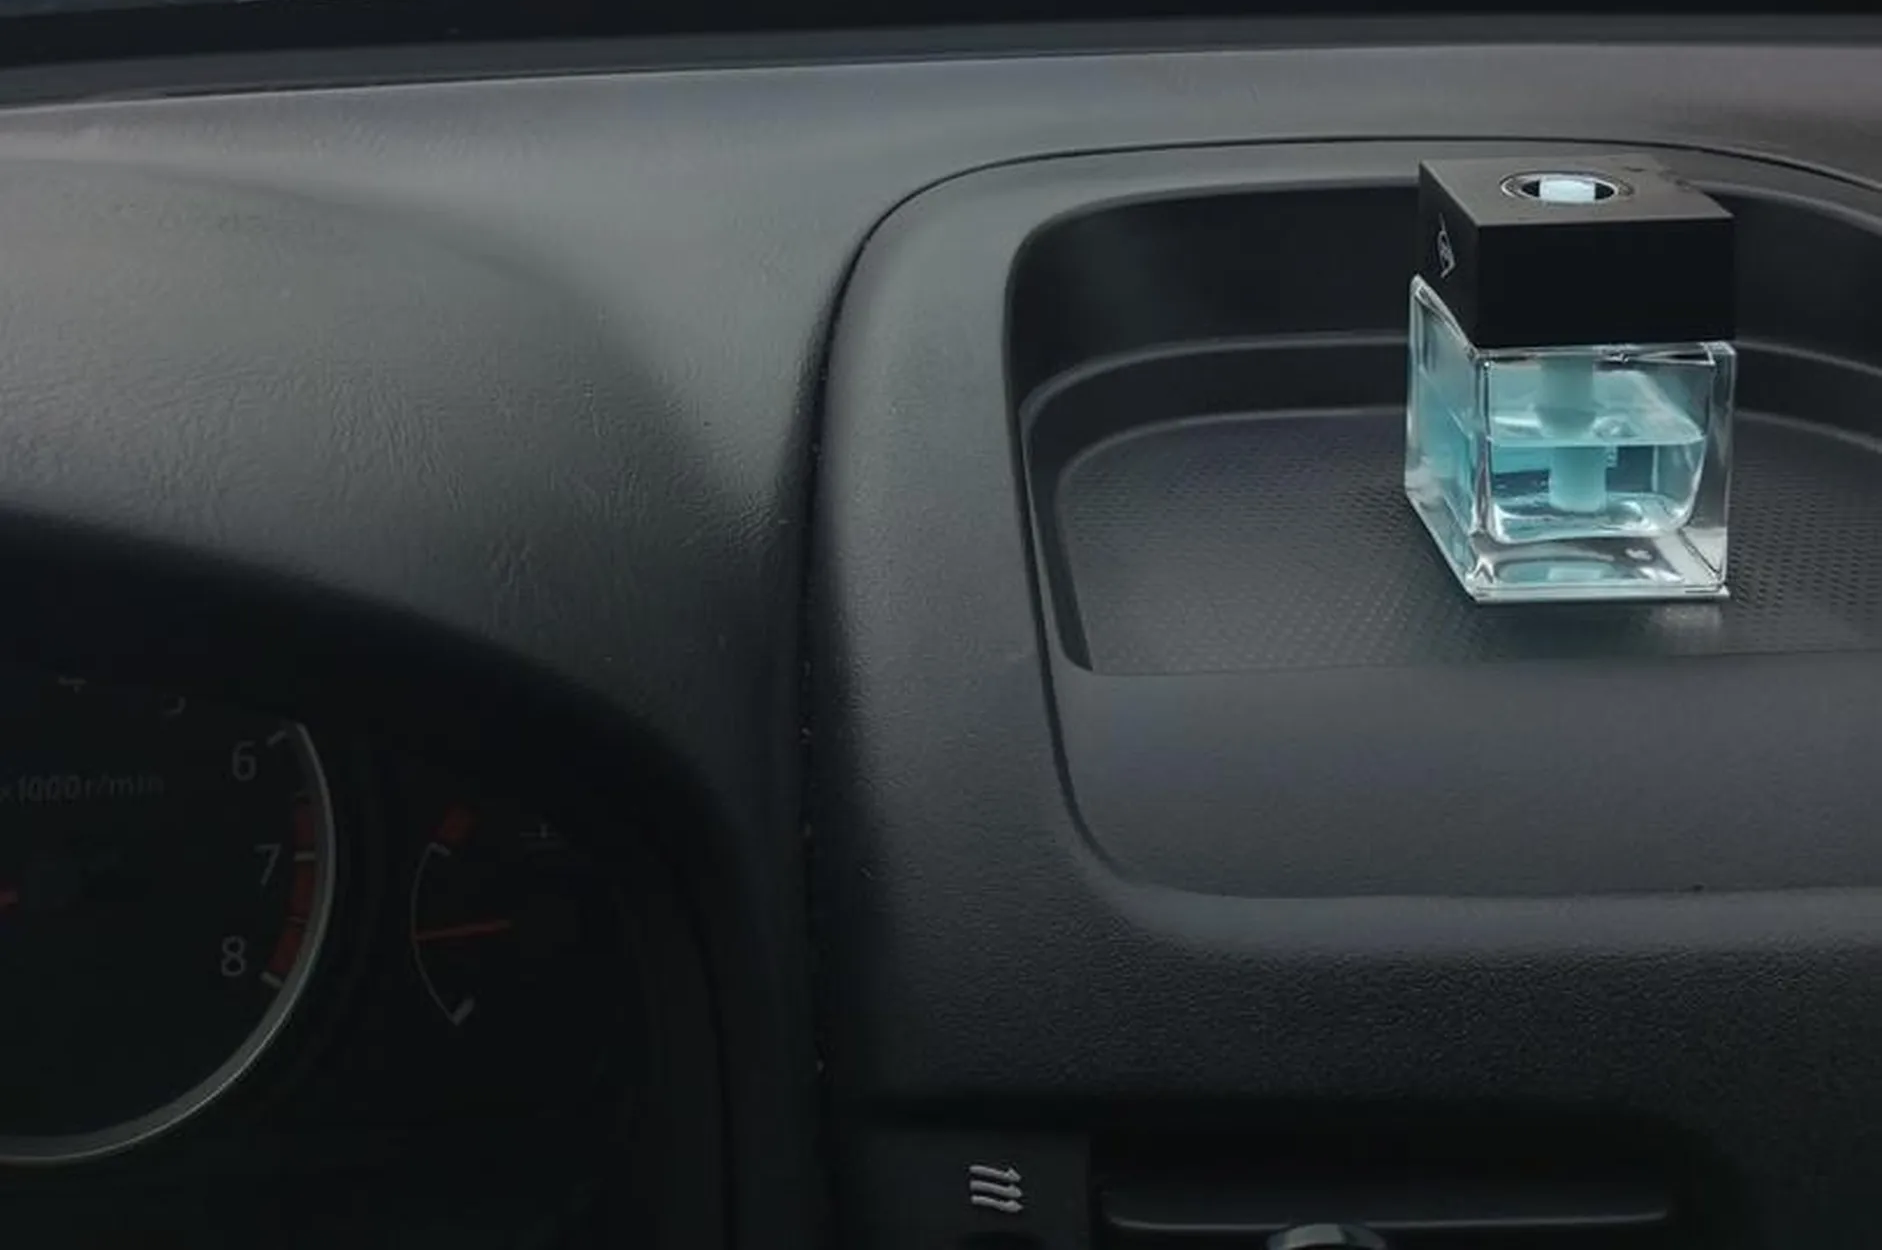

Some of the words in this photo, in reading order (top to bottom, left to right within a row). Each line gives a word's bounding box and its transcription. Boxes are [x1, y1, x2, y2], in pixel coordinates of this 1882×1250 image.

[230, 739, 258, 782] 6
[253, 842, 283, 887] 7
[220, 934, 249, 978] 8
